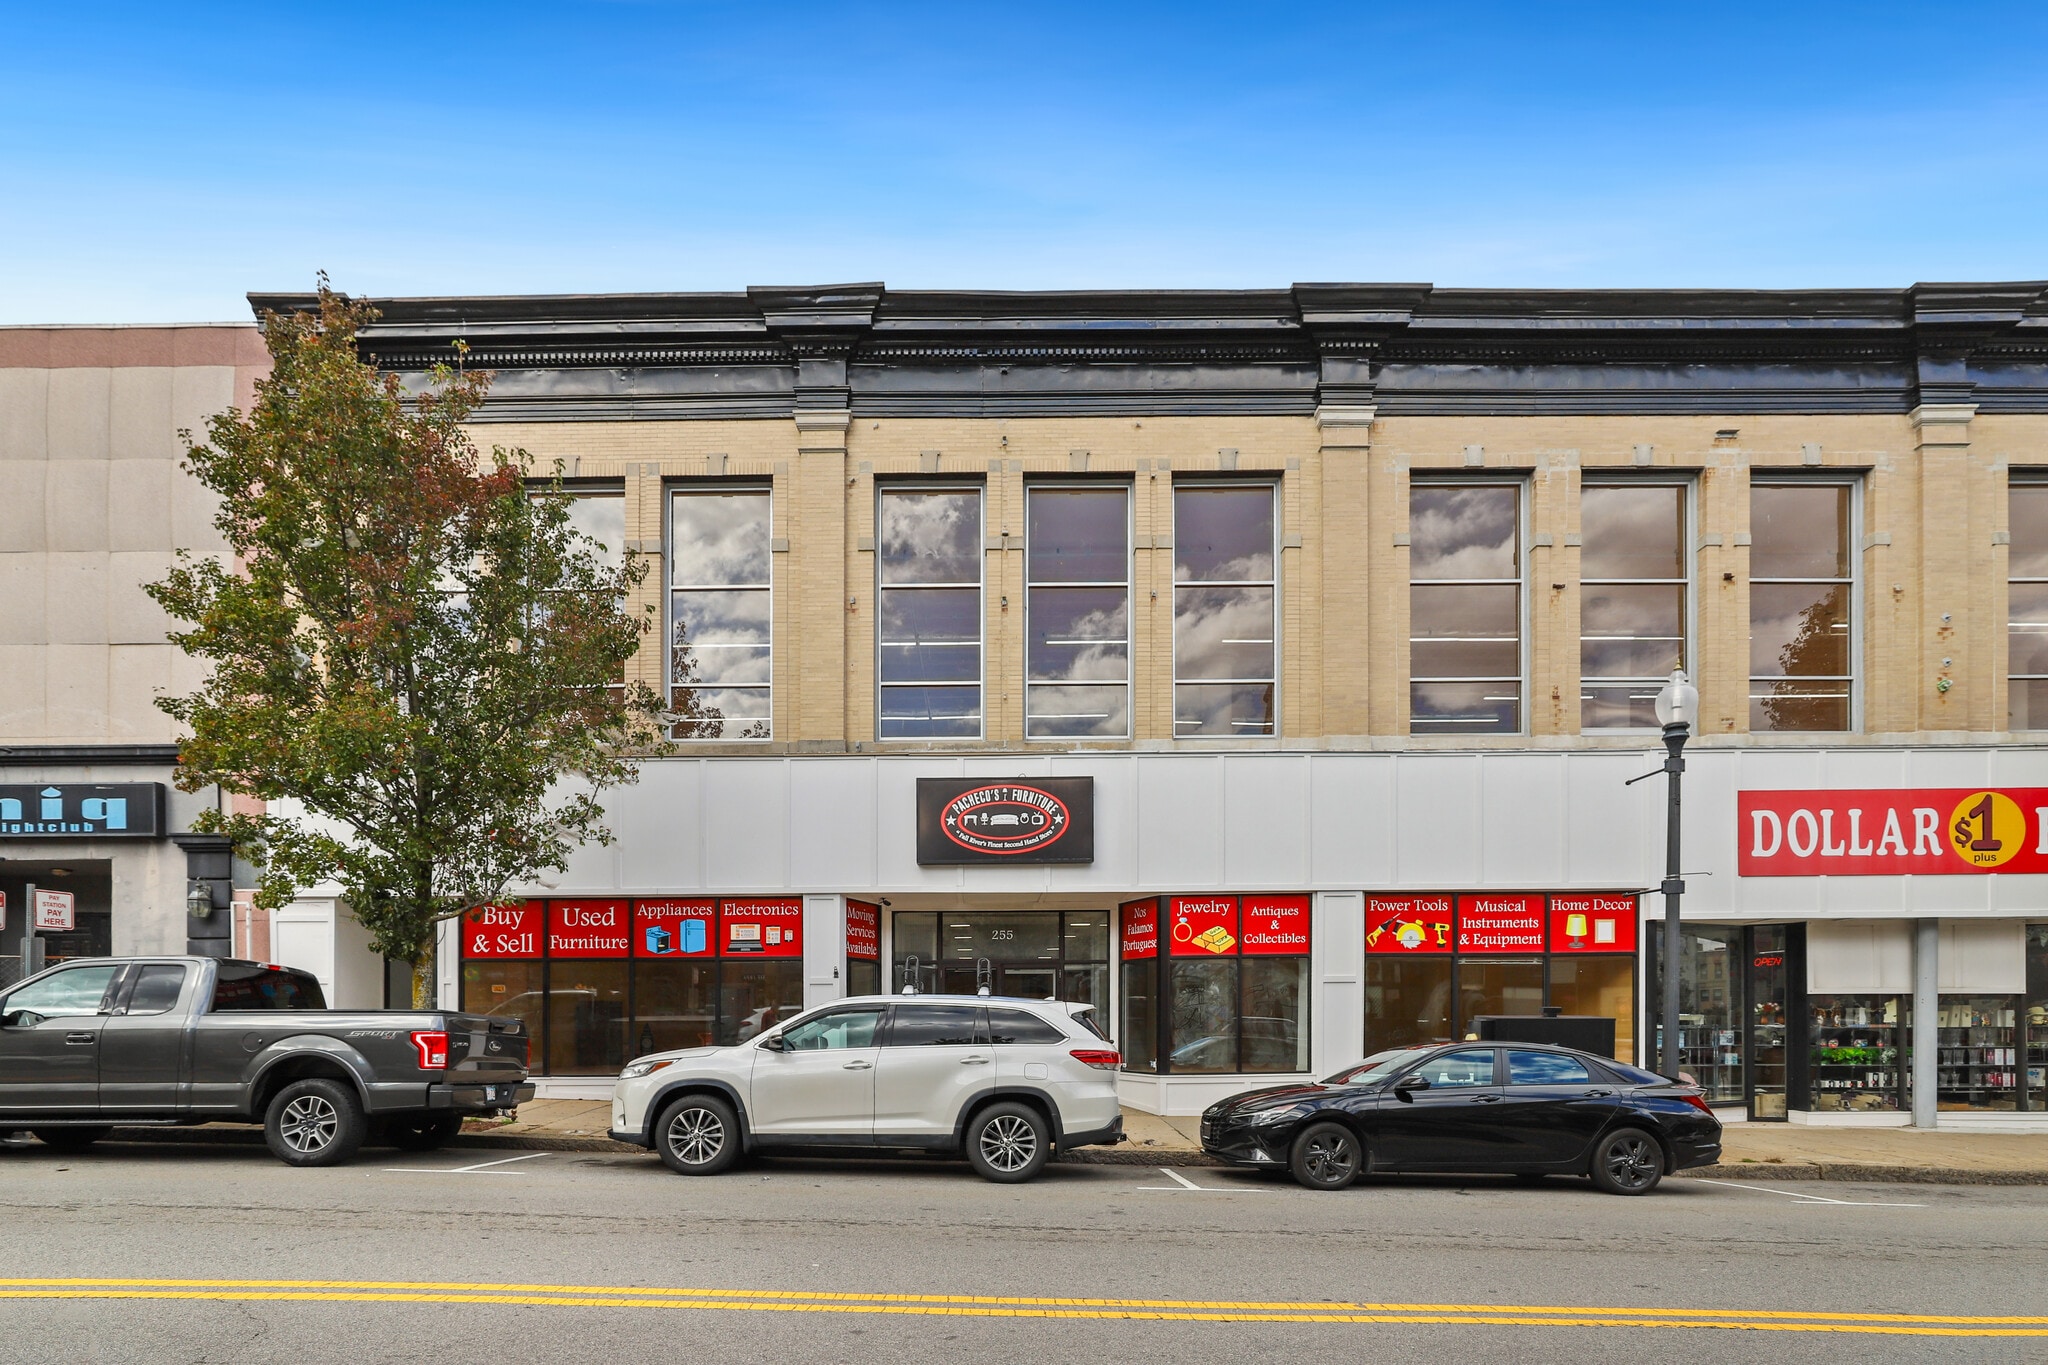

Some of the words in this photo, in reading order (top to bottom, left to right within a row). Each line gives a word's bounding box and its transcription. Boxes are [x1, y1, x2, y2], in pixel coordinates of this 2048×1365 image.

[951, 788, 1000, 815] PACHECO'S
[1012, 788, 1060, 814] FURNITURE
[1751, 807, 1944, 858] DOLLAR
[1973, 853, 1997, 863] plus
[42, 901, 67, 909] STATION
[637, 903, 713, 919] Appliances
[723, 903, 799, 917] Electronics
[1176, 901, 1231, 917] Jewelry
[1251, 906, 1299, 917] Antiques
[1369, 898, 1411, 913] Power
[1413, 898, 1449, 912] Tools
[1475, 900, 1527, 913] Musical
[1551, 899, 1590, 912] Home
[1592, 898, 1633, 912] Decor
[47, 908, 63, 917] PAY
[482, 906, 525, 931] Buy
[562, 906, 616, 927] Used
[847, 906, 875, 926] Moving
[1134, 907, 1147, 919] Nos
[43, 918, 66, 926] HERE
[1127, 922, 1154, 936] Falamos
[1270, 920, 1280, 930] &
[1462, 916, 1540, 930] Instruments
[846, 923, 876, 939] Services
[991, 930, 1014, 940] 255
[472, 934, 491, 953] &
[496, 933, 534, 953] Sell
[550, 934, 629, 950] Furniture
[1123, 938, 1158, 953] Portuguese
[1243, 933, 1307, 945] Collectibles
[1459, 934, 1469, 945] &
[1473, 933, 1542, 949] Equipment
[845, 941, 878, 956] Available
[1753, 956, 1783, 968] OPEN
[344, 1030, 404, 1038] SPORT
